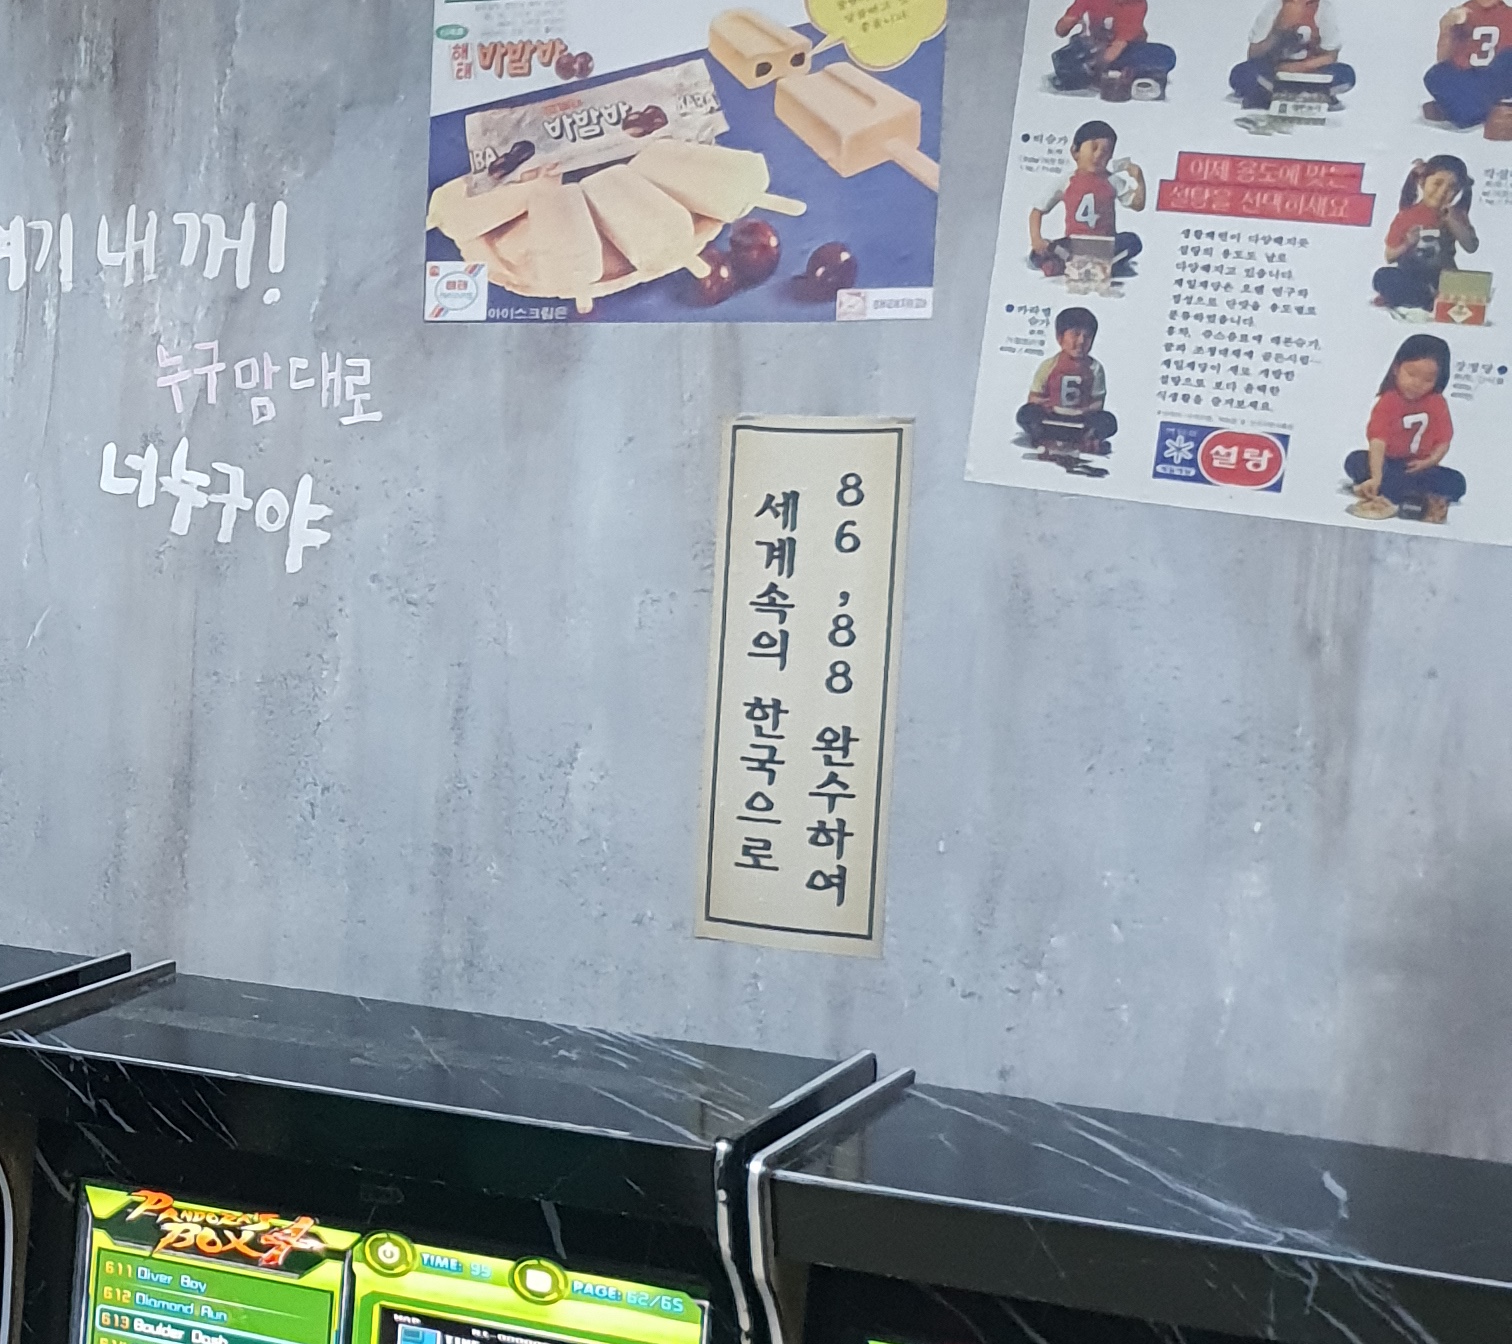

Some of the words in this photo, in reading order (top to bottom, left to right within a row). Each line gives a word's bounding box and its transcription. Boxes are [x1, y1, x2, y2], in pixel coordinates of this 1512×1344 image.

[1469, 25, 1500, 68] 3
[1075, 192, 1101, 230] 4
[487, 306, 568, 321] 아이스크림은
[1060, 374, 1083, 407] 6
[1402, 411, 1430, 455] 7
[746, 489, 801, 672] 세계속의
[733, 696, 790, 873] 한국으로
[804, 724, 861, 907] 완수하여
[152, 1222, 266, 1259] BOX
[136, 1266, 173, 1286] Diver
[180, 1274, 207, 1294] Boy
[421, 1252, 463, 1273] TIME:
[135, 1291, 194, 1317] Diamond
[200, 1305, 228, 1323] Run
[571, 1279, 622, 1302] PAGE:
[134, 1317, 185, 1342] Boulder
